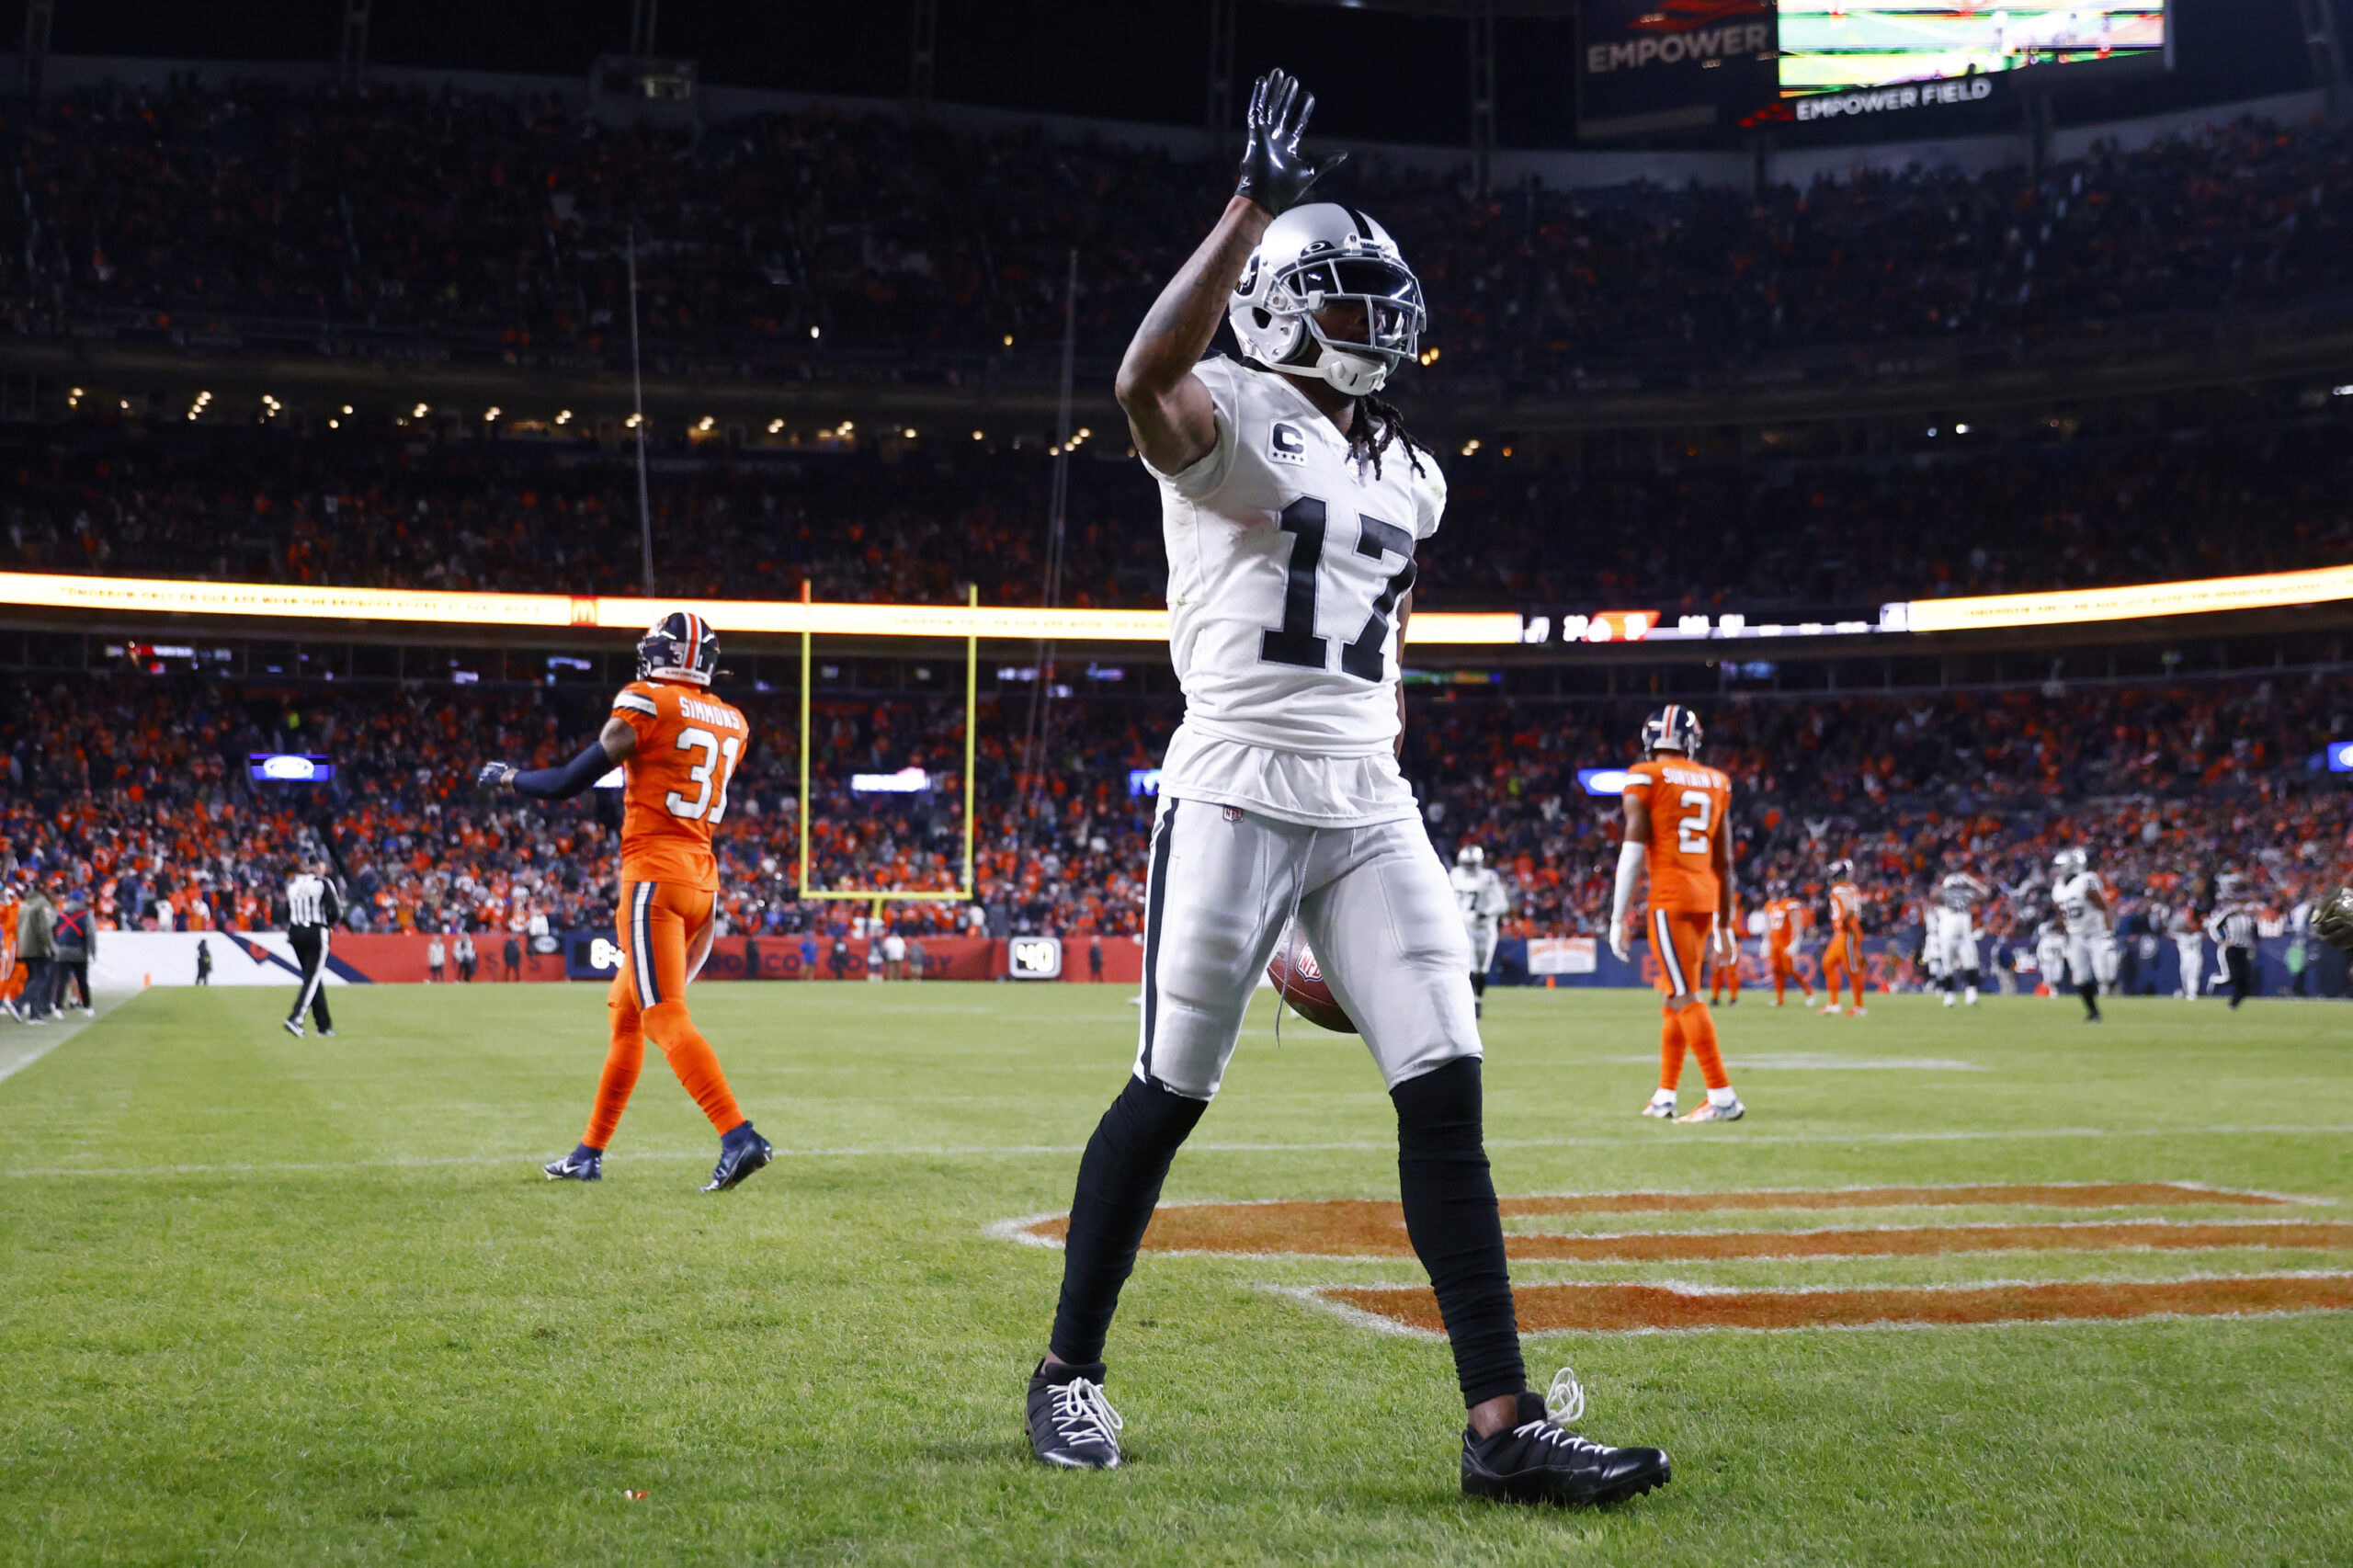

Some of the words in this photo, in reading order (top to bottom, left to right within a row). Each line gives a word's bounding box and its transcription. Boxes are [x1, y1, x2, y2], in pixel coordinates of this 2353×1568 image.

[1587, 23, 1767, 74] EMPOWER
[1796, 85, 1917, 120] EMPOWER
[1921, 77, 1993, 106] FIELD
[1272, 422, 1303, 455] C
[1257, 492, 1418, 684] 17
[678, 696, 741, 730] SIMMONS
[665, 727, 740, 824] 31
[1678, 790, 1711, 854] 2
[1016, 942, 1055, 972] 40
